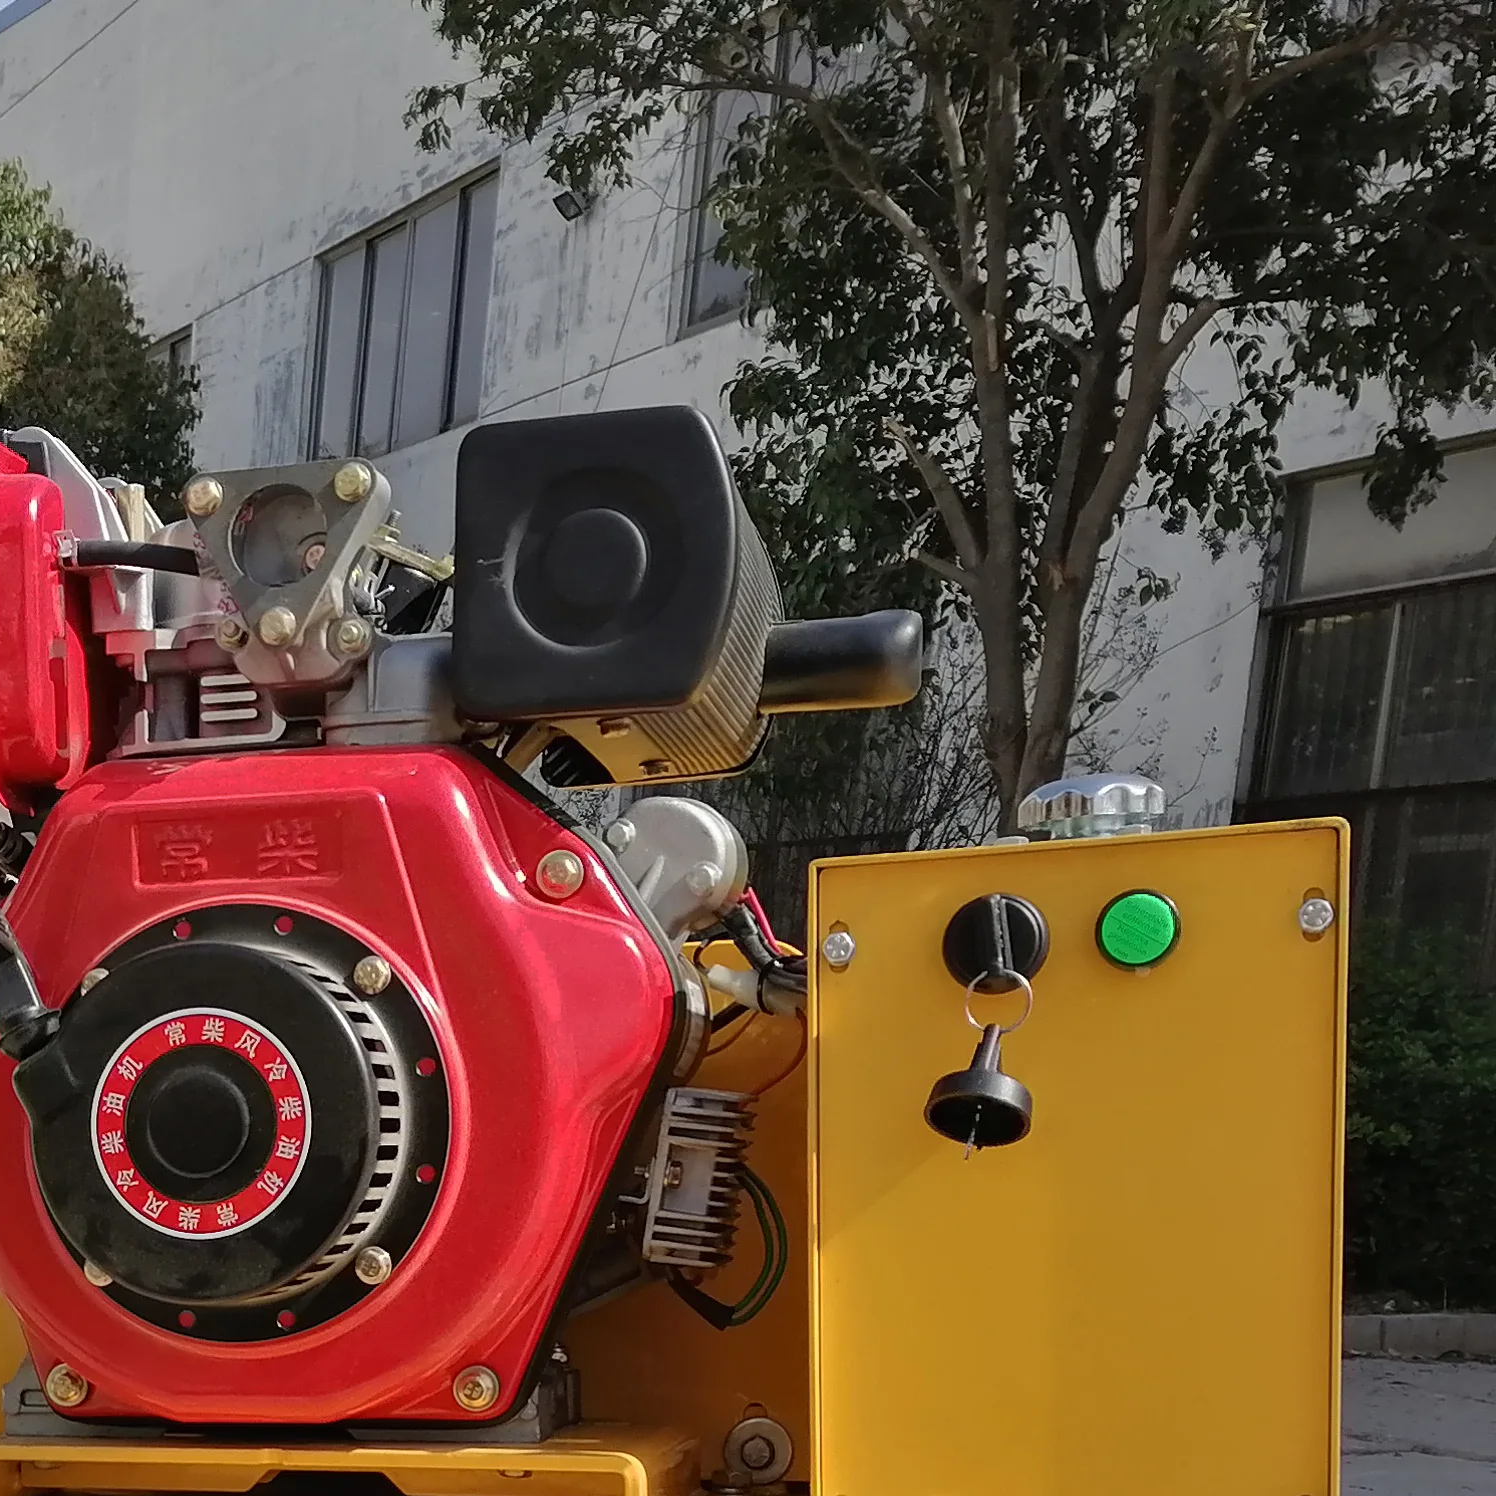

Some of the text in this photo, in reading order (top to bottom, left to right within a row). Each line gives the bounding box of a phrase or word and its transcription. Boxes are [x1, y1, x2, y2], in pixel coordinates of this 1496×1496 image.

[156, 819, 319, 879] 常柴
[101, 1055, 239, 1231] 常柴风冷柴油机
[164, 1018, 303, 1196] 常柴风冷柴油机
